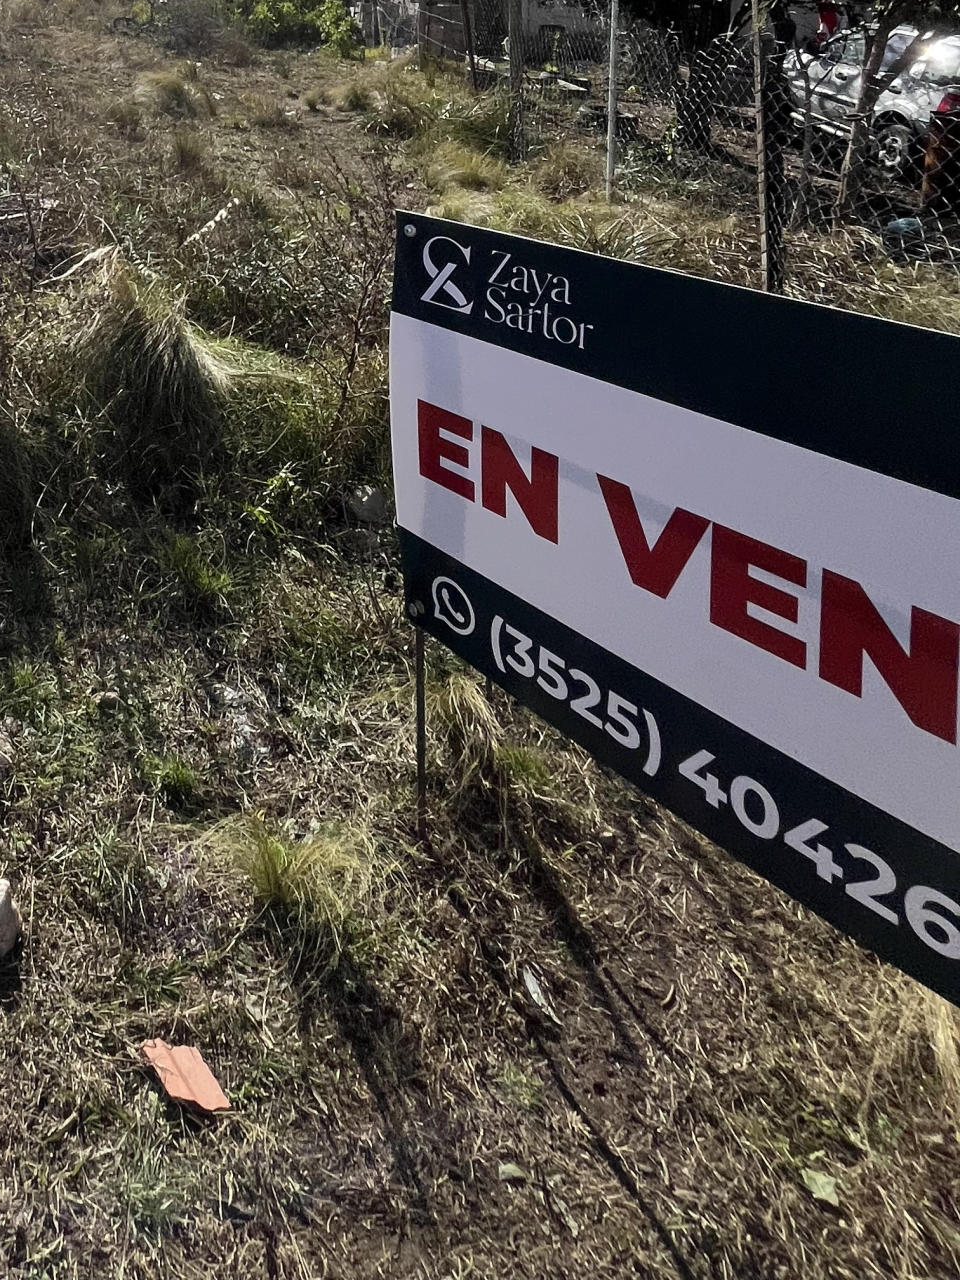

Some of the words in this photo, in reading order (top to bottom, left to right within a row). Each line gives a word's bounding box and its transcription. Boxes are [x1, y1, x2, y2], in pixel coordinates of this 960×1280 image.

[484, 286, 594, 350] Sartor
[488, 250, 572, 306] Zaya
[417, 398, 559, 545] EN
[596, 472, 960, 746] VEN
[490, 614, 662, 777] (3525)
[678, 748, 960, 960] 40426
